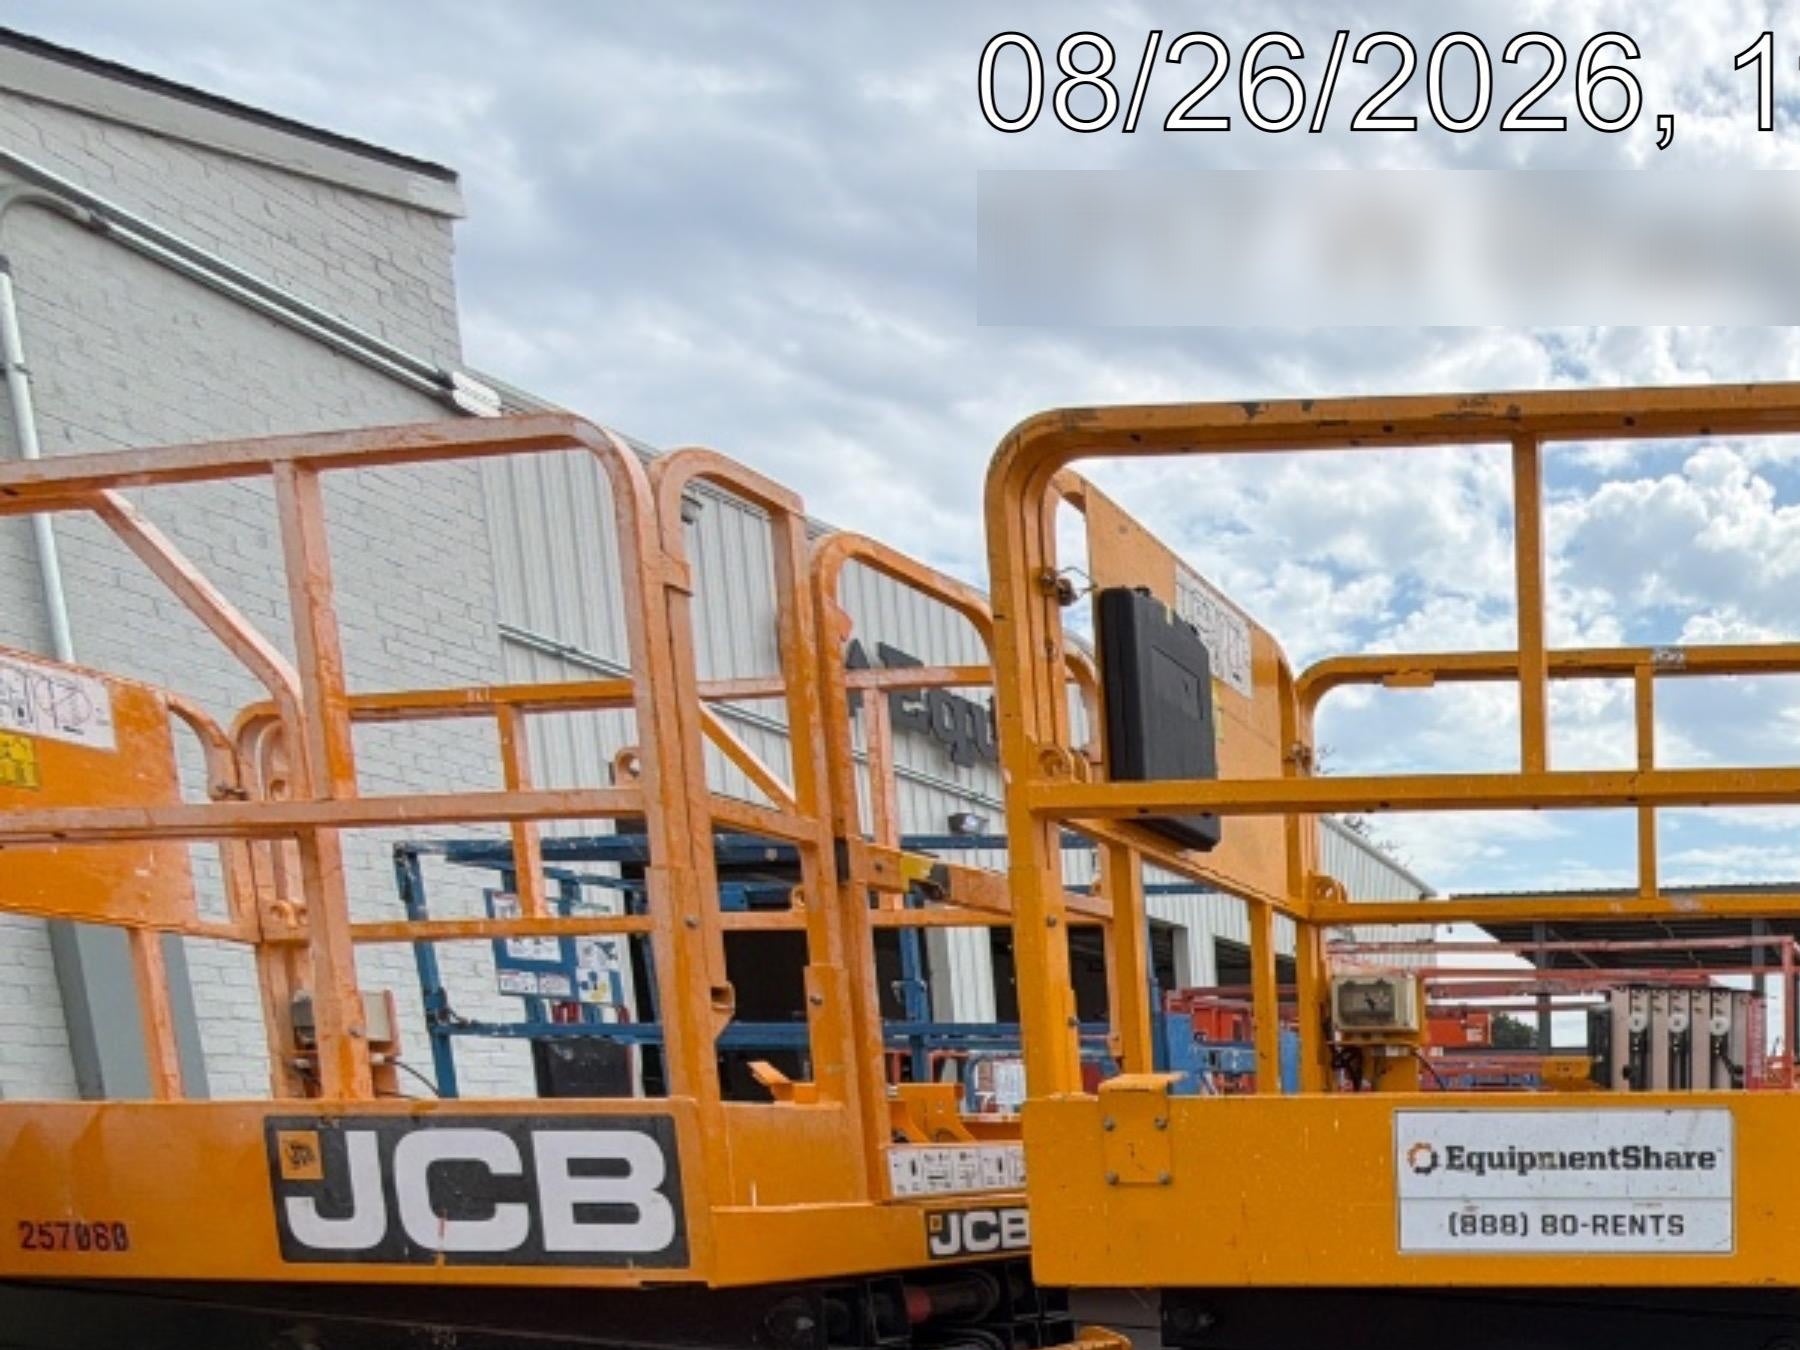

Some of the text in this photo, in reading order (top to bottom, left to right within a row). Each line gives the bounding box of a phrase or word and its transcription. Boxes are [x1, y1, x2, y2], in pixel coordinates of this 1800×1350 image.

[1445, 1145, 1717, 1176] EquipmentShare
[284, 1127, 676, 1252] JCB
[1448, 1213, 1528, 1237] (888)
